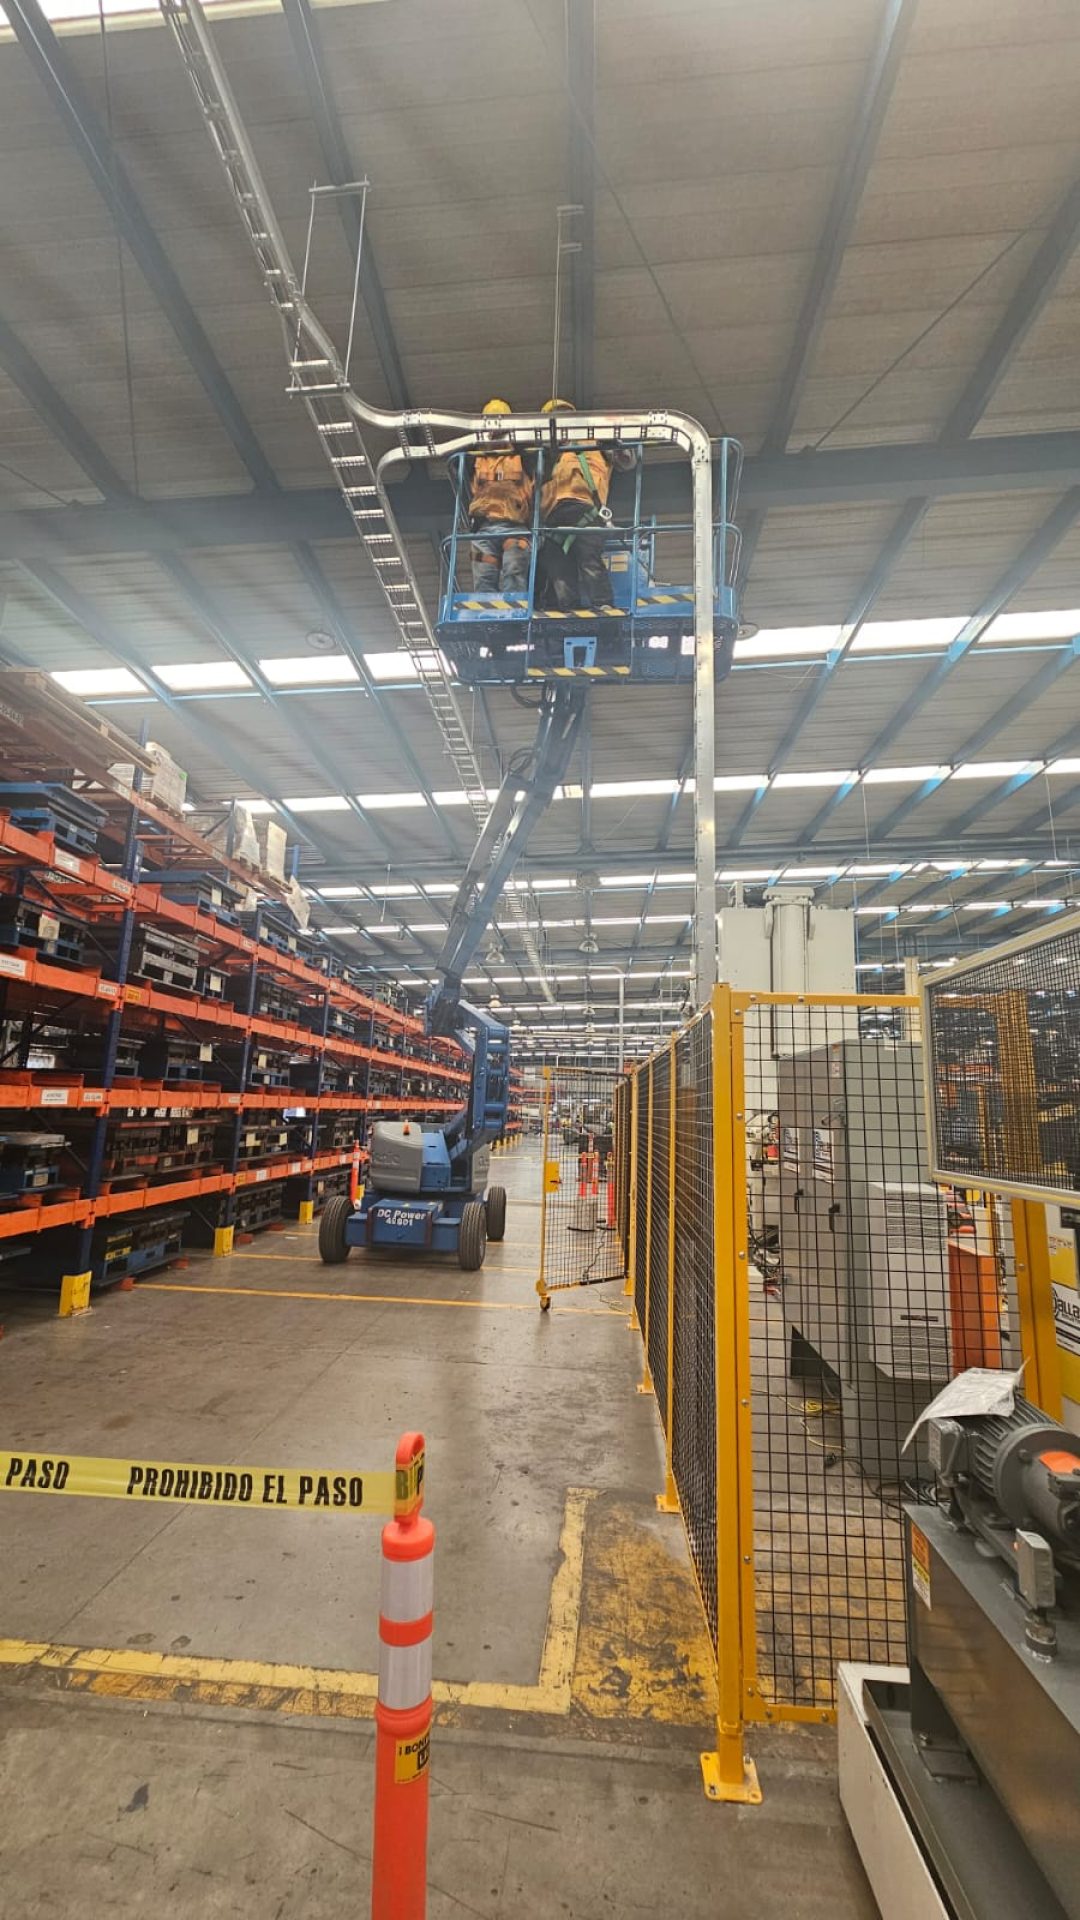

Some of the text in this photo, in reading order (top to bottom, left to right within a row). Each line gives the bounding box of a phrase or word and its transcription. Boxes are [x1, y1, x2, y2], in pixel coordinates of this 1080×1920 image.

[377, 1209, 427, 1220] DC Power
[5, 1458, 69, 1490] PASO
[127, 1466, 252, 1502] PROHIBIDO
[262, 1475, 287, 1504] EL
[298, 1475, 363, 1507] PASO
